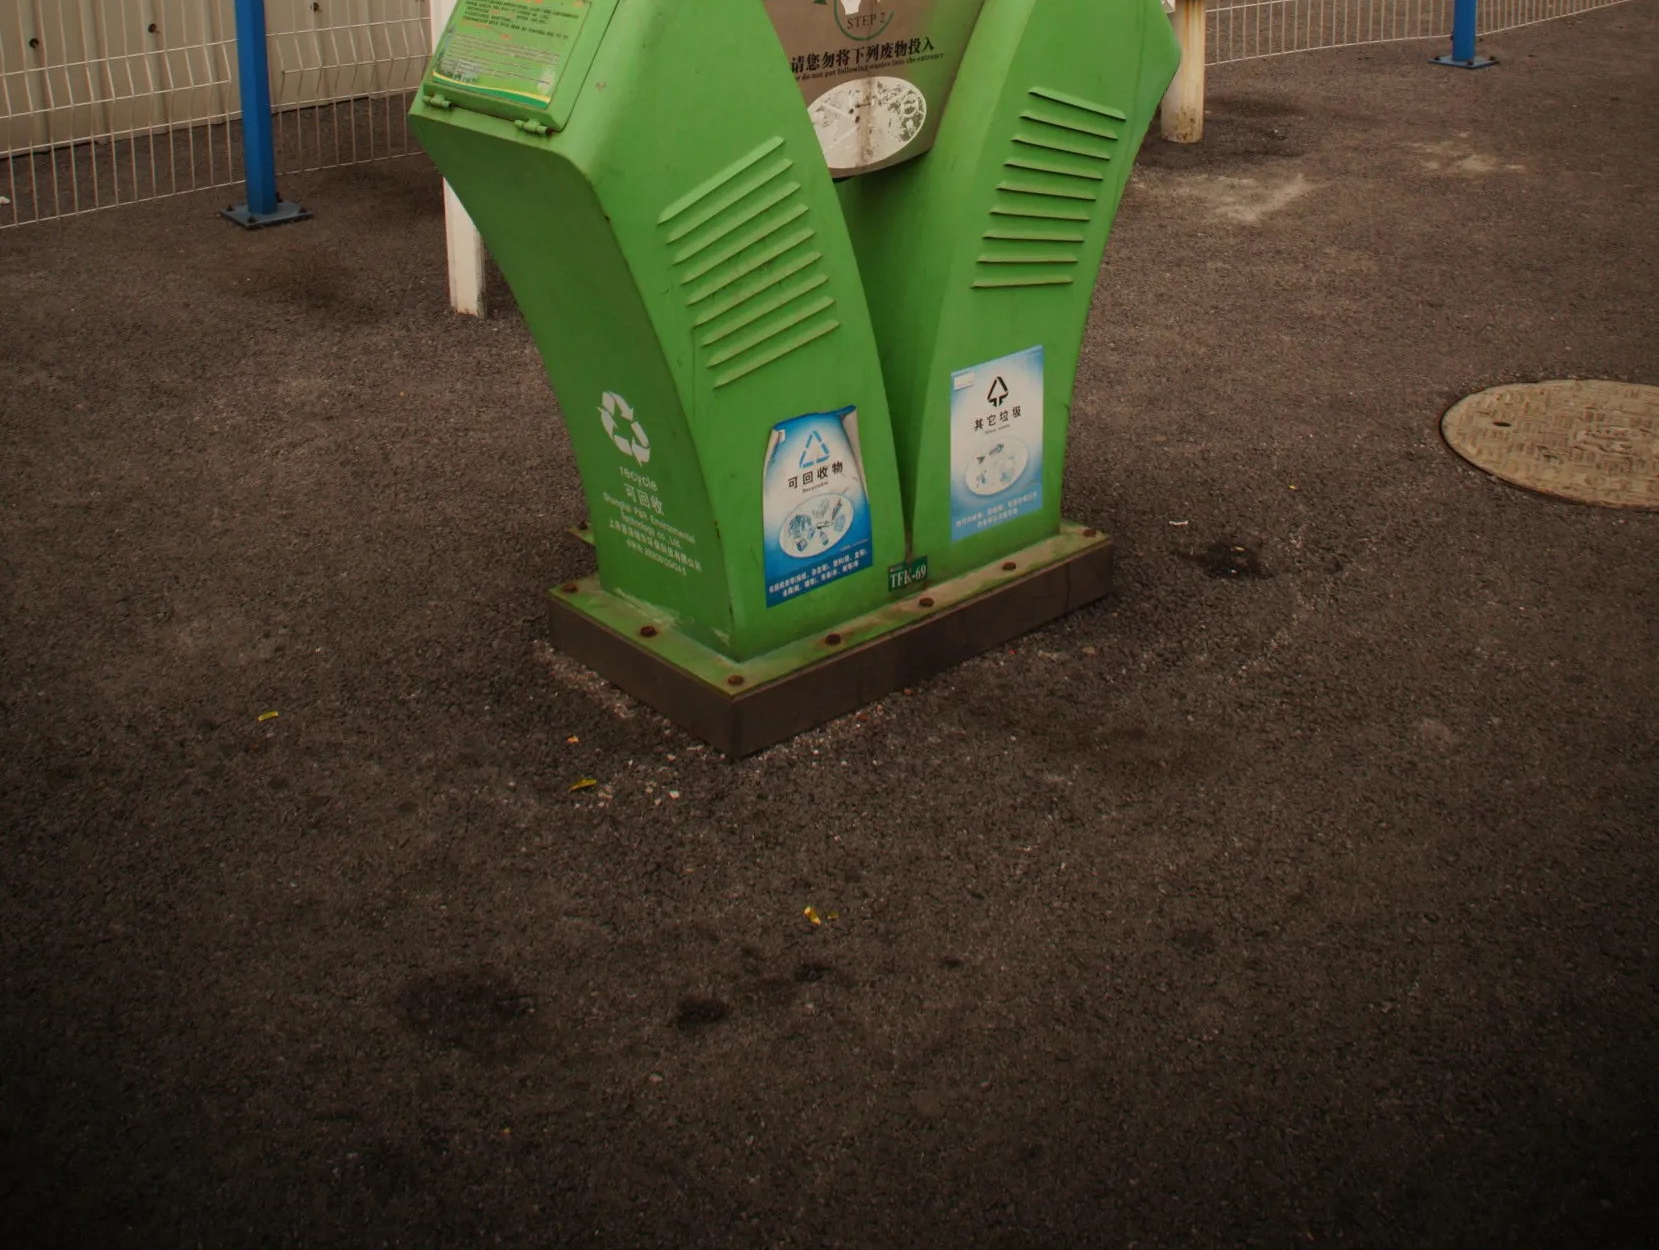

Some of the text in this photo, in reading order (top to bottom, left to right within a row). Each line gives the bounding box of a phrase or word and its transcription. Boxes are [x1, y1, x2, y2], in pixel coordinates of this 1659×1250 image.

[846, 12, 886, 31] STEP 2
[791, 36, 935, 74] 请您勿将下列废物投入
[812, 72, 824, 80] not
[824, 70, 837, 79] put
[837, 65, 869, 76] following
[869, 61, 891, 70] wastes
[891, 59, 906, 68] into
[973, 405, 1022, 432] 其它垃圾
[787, 460, 844, 490] 可回收物
[623, 482, 665, 516] 可回收
[889, 564, 927, 589] TFK-69
